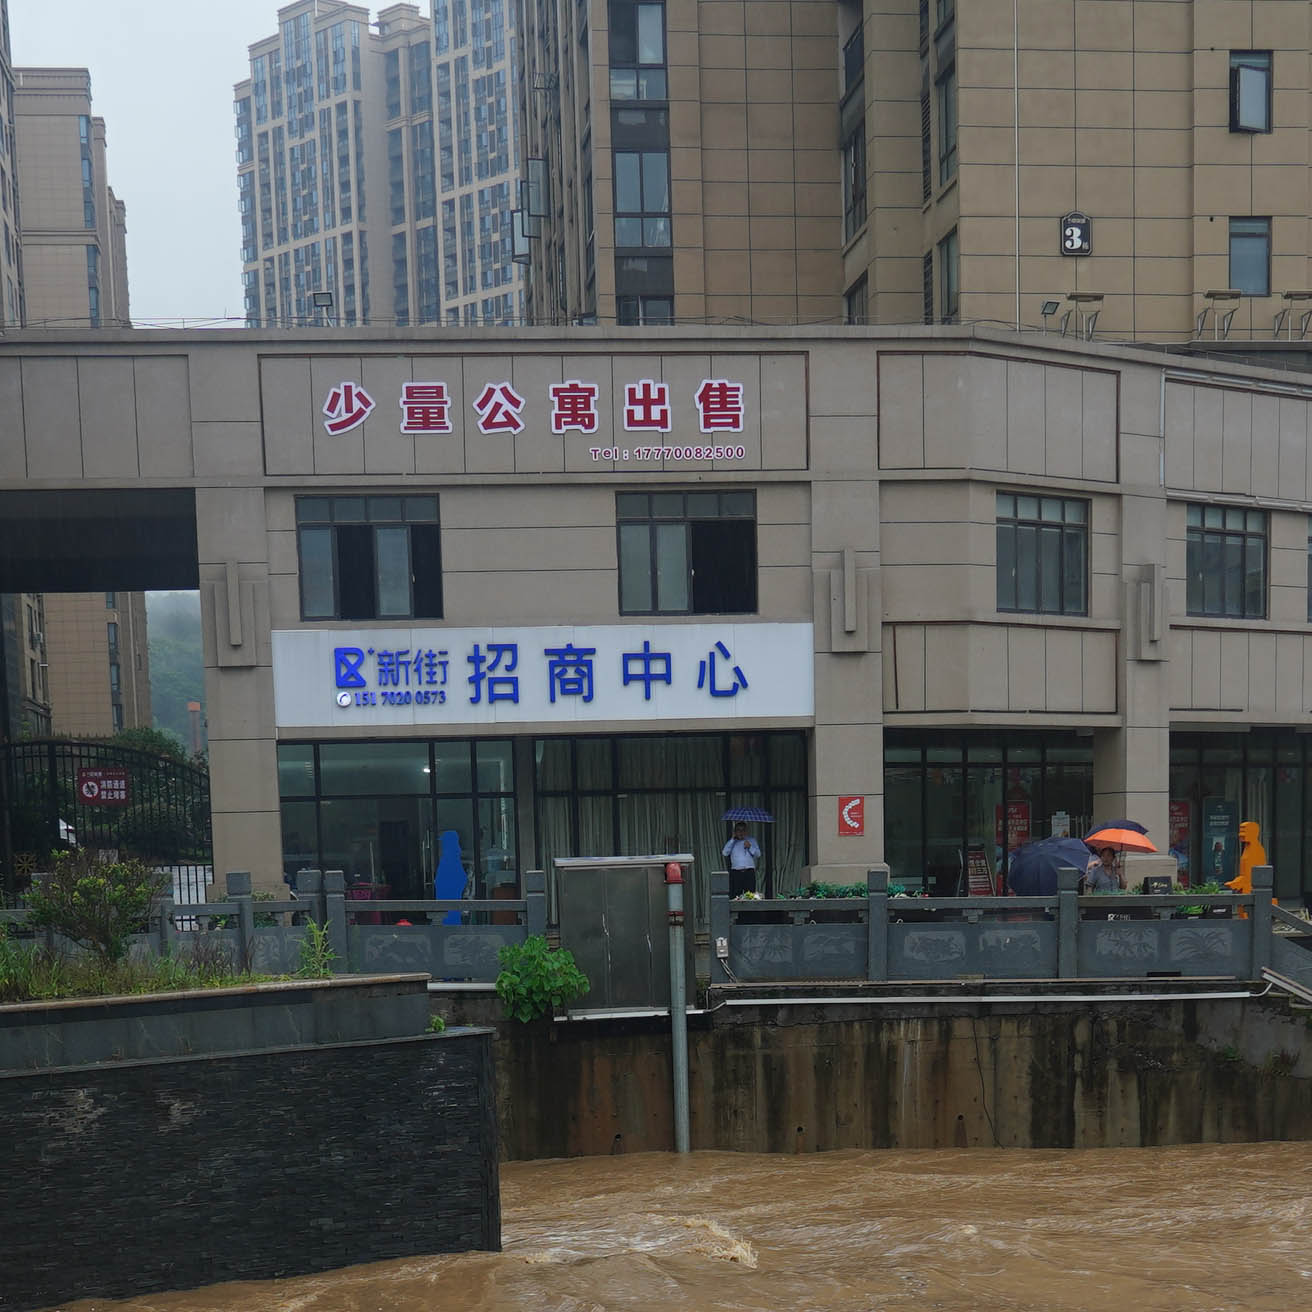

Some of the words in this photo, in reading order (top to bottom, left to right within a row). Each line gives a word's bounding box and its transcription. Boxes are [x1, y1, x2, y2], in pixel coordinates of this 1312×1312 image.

[323, 380, 745, 434] 少量公寓出售
[467, 640, 749, 706] 招商中心
